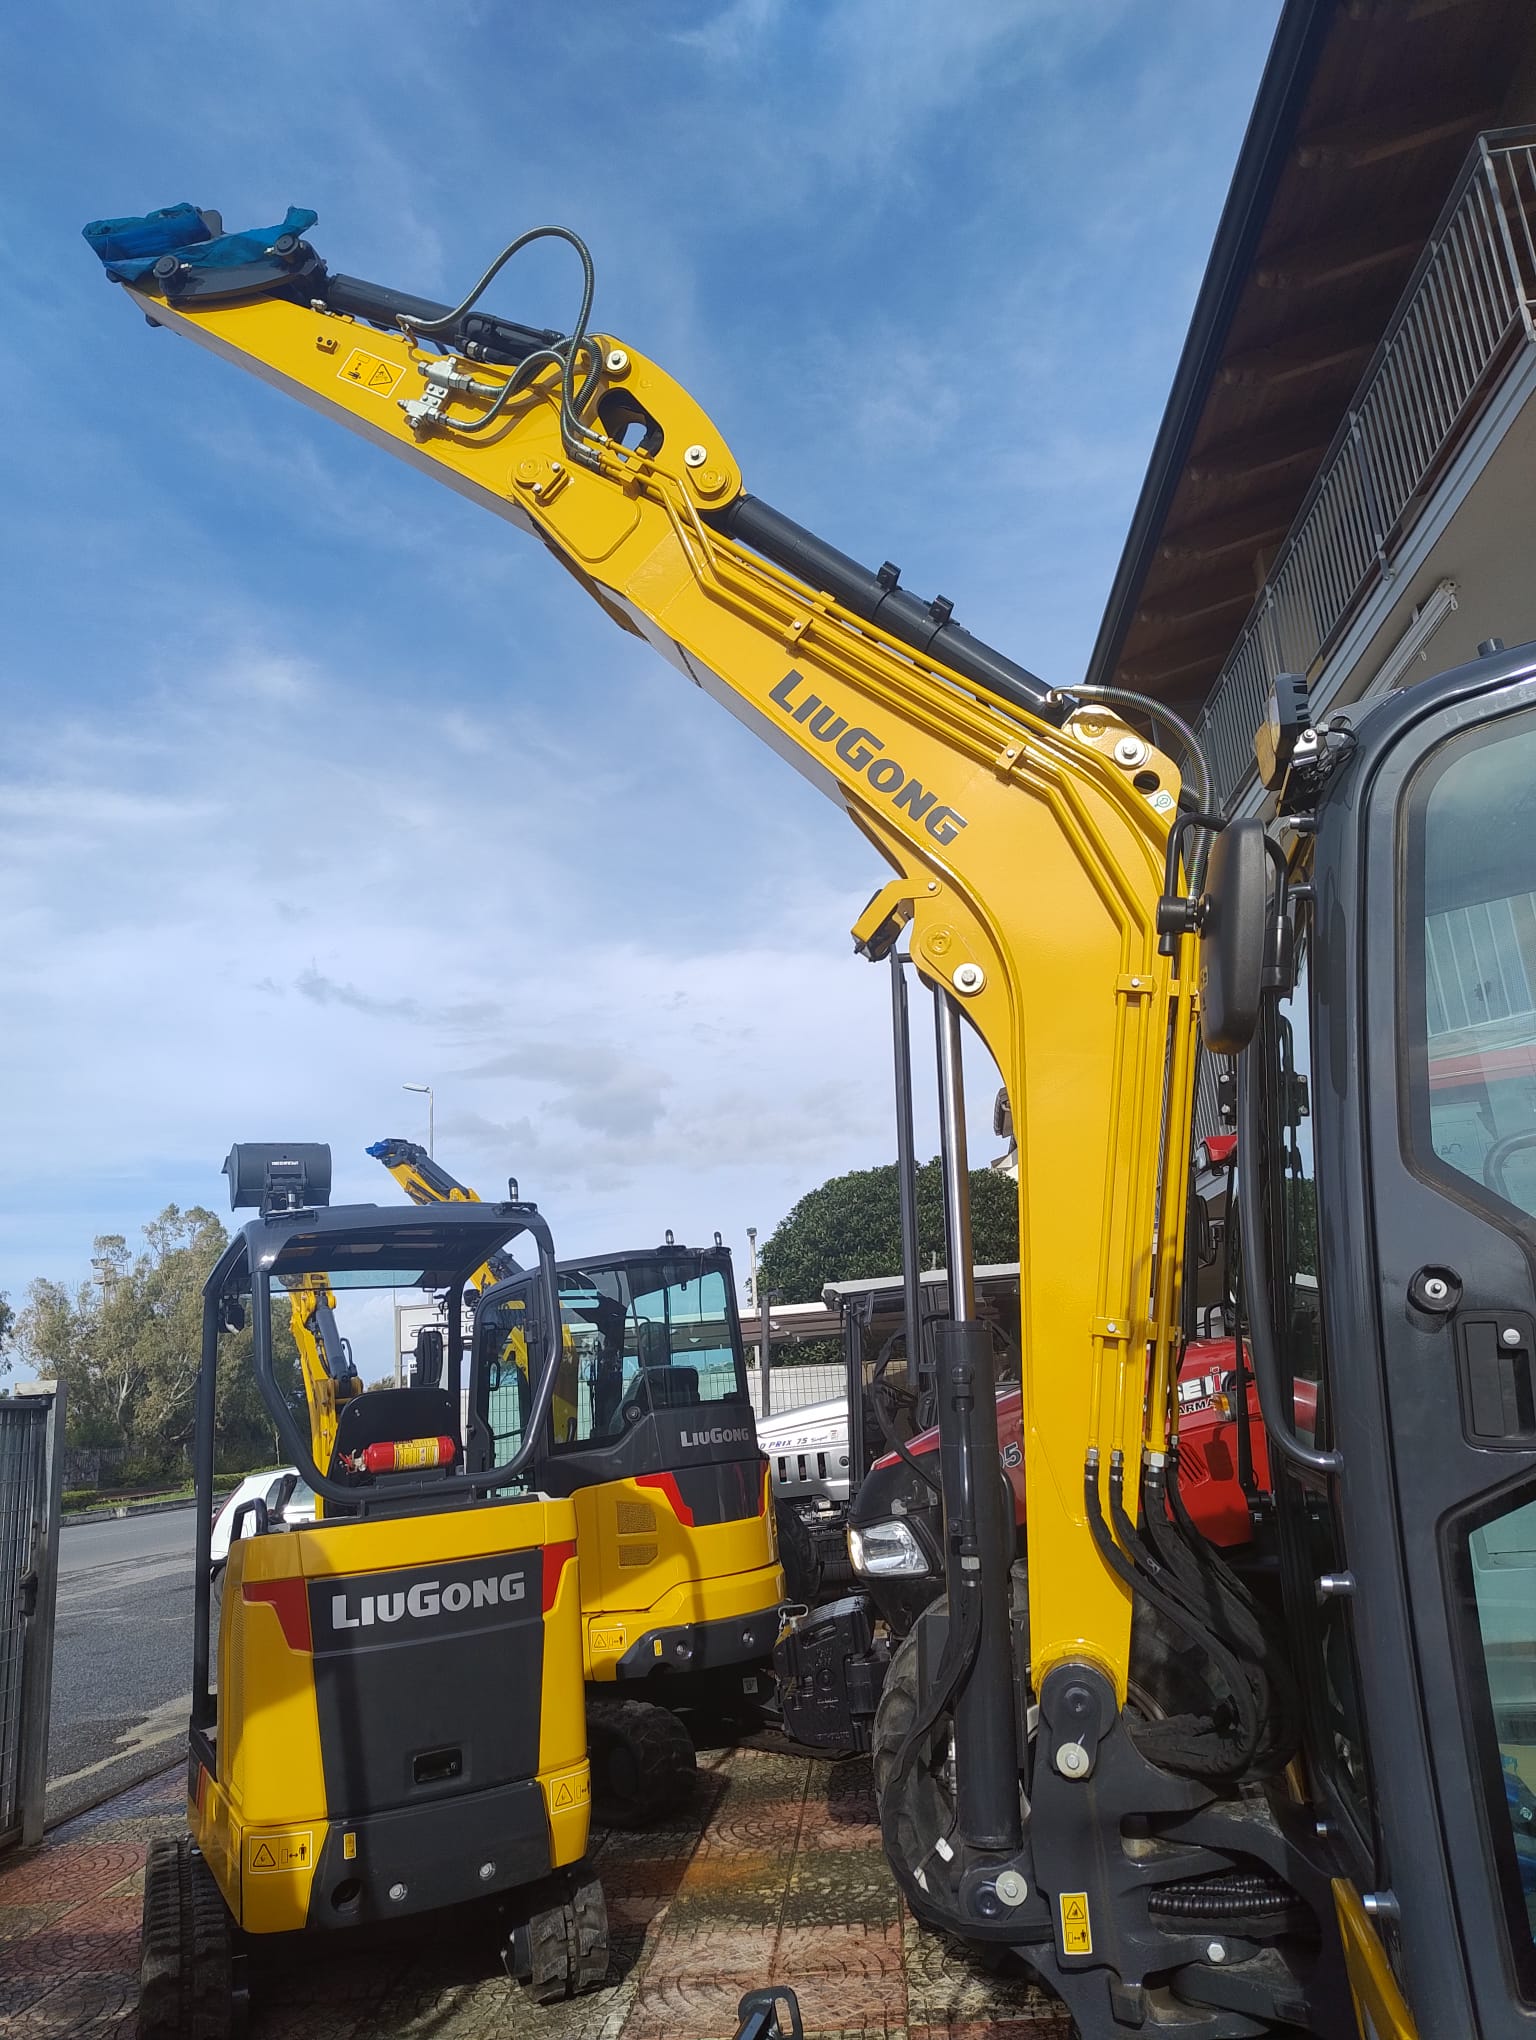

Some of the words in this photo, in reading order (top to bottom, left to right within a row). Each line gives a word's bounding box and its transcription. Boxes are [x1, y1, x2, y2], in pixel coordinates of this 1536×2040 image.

[769, 669, 968, 846] LIUGONG
[680, 1427, 750, 1448] LIUGONG
[332, 1571, 526, 1630] LIUGONG
